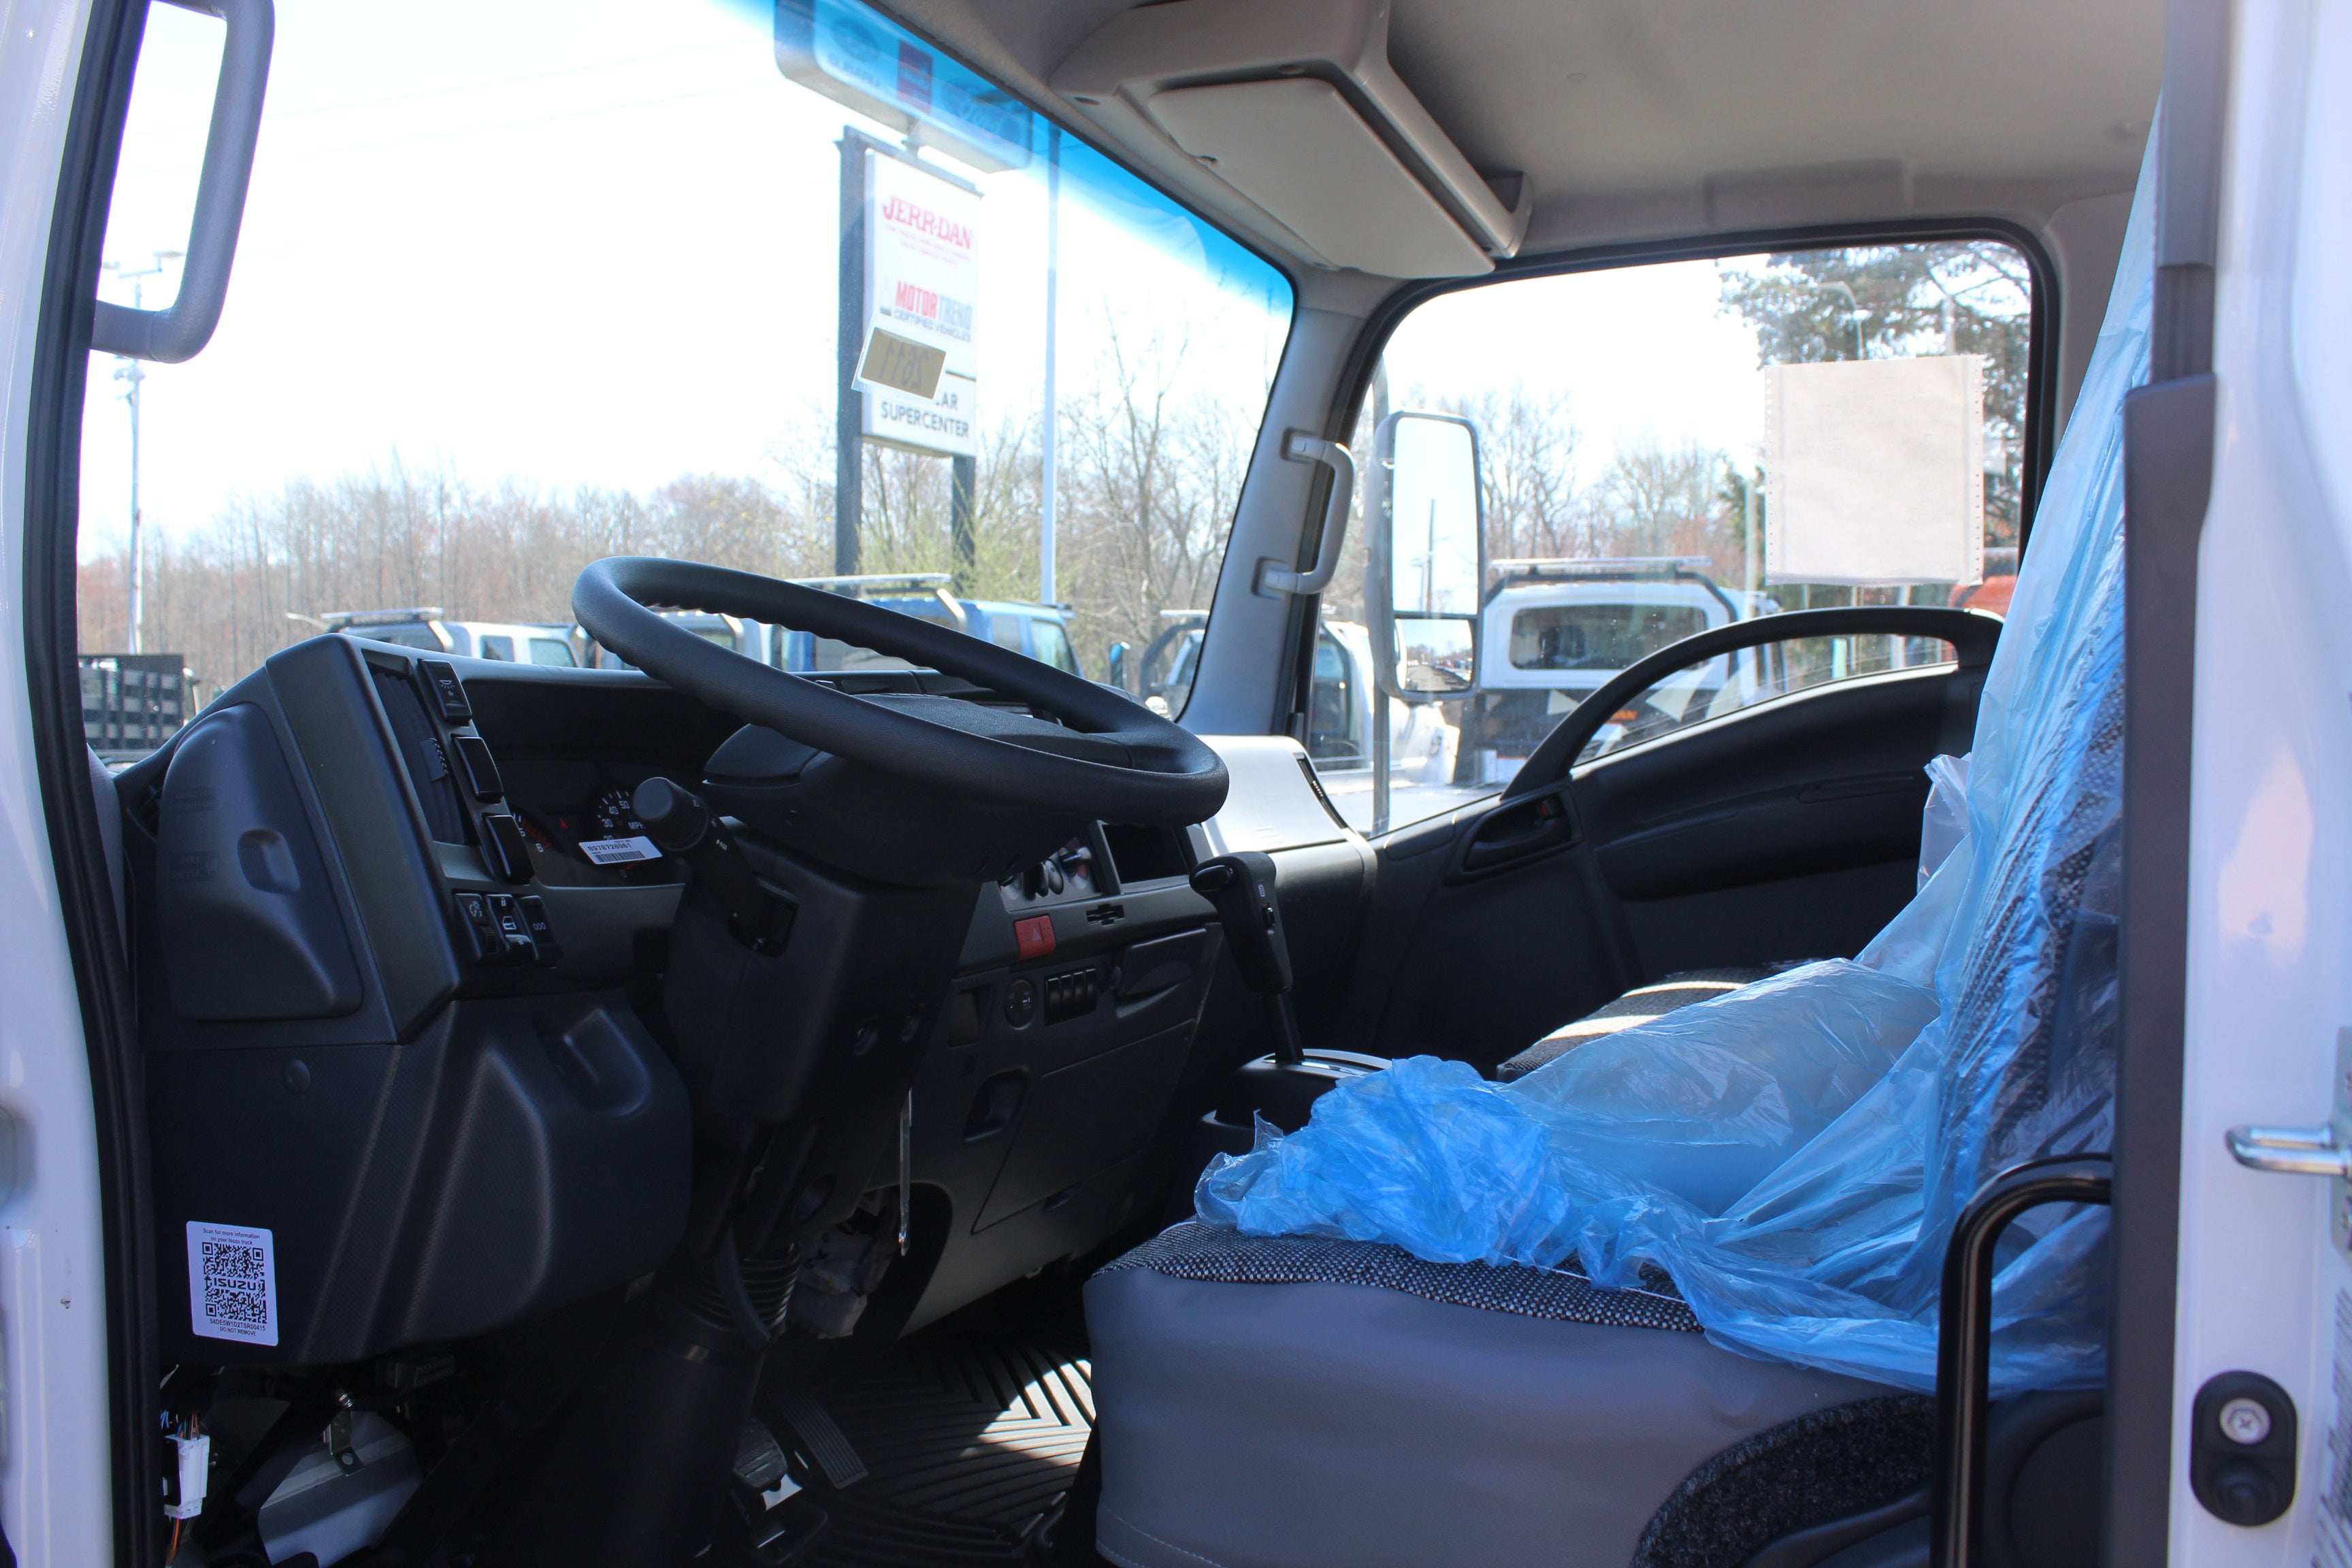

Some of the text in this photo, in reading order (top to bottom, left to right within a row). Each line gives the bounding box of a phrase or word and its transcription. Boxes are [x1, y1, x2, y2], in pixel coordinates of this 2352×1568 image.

[828, 52, 882, 88] SUBARU
[882, 195, 973, 250] JERR-DAN
[895, 280, 973, 331] MOTOR TREND
[893, 307, 934, 331] CERTIFIED
[934, 391, 958, 410] AR
[881, 400, 969, 438] SUPERCENTER
[609, 806, 619, 815] 40
[619, 800, 630, 809] 50
[602, 818, 613, 828] 30
[536, 843, 544, 853] 6
[533, 922, 546, 931] ODO
[214, 1277, 257, 1291] ISUZU
[238, 1328, 257, 1337] REMOVE
